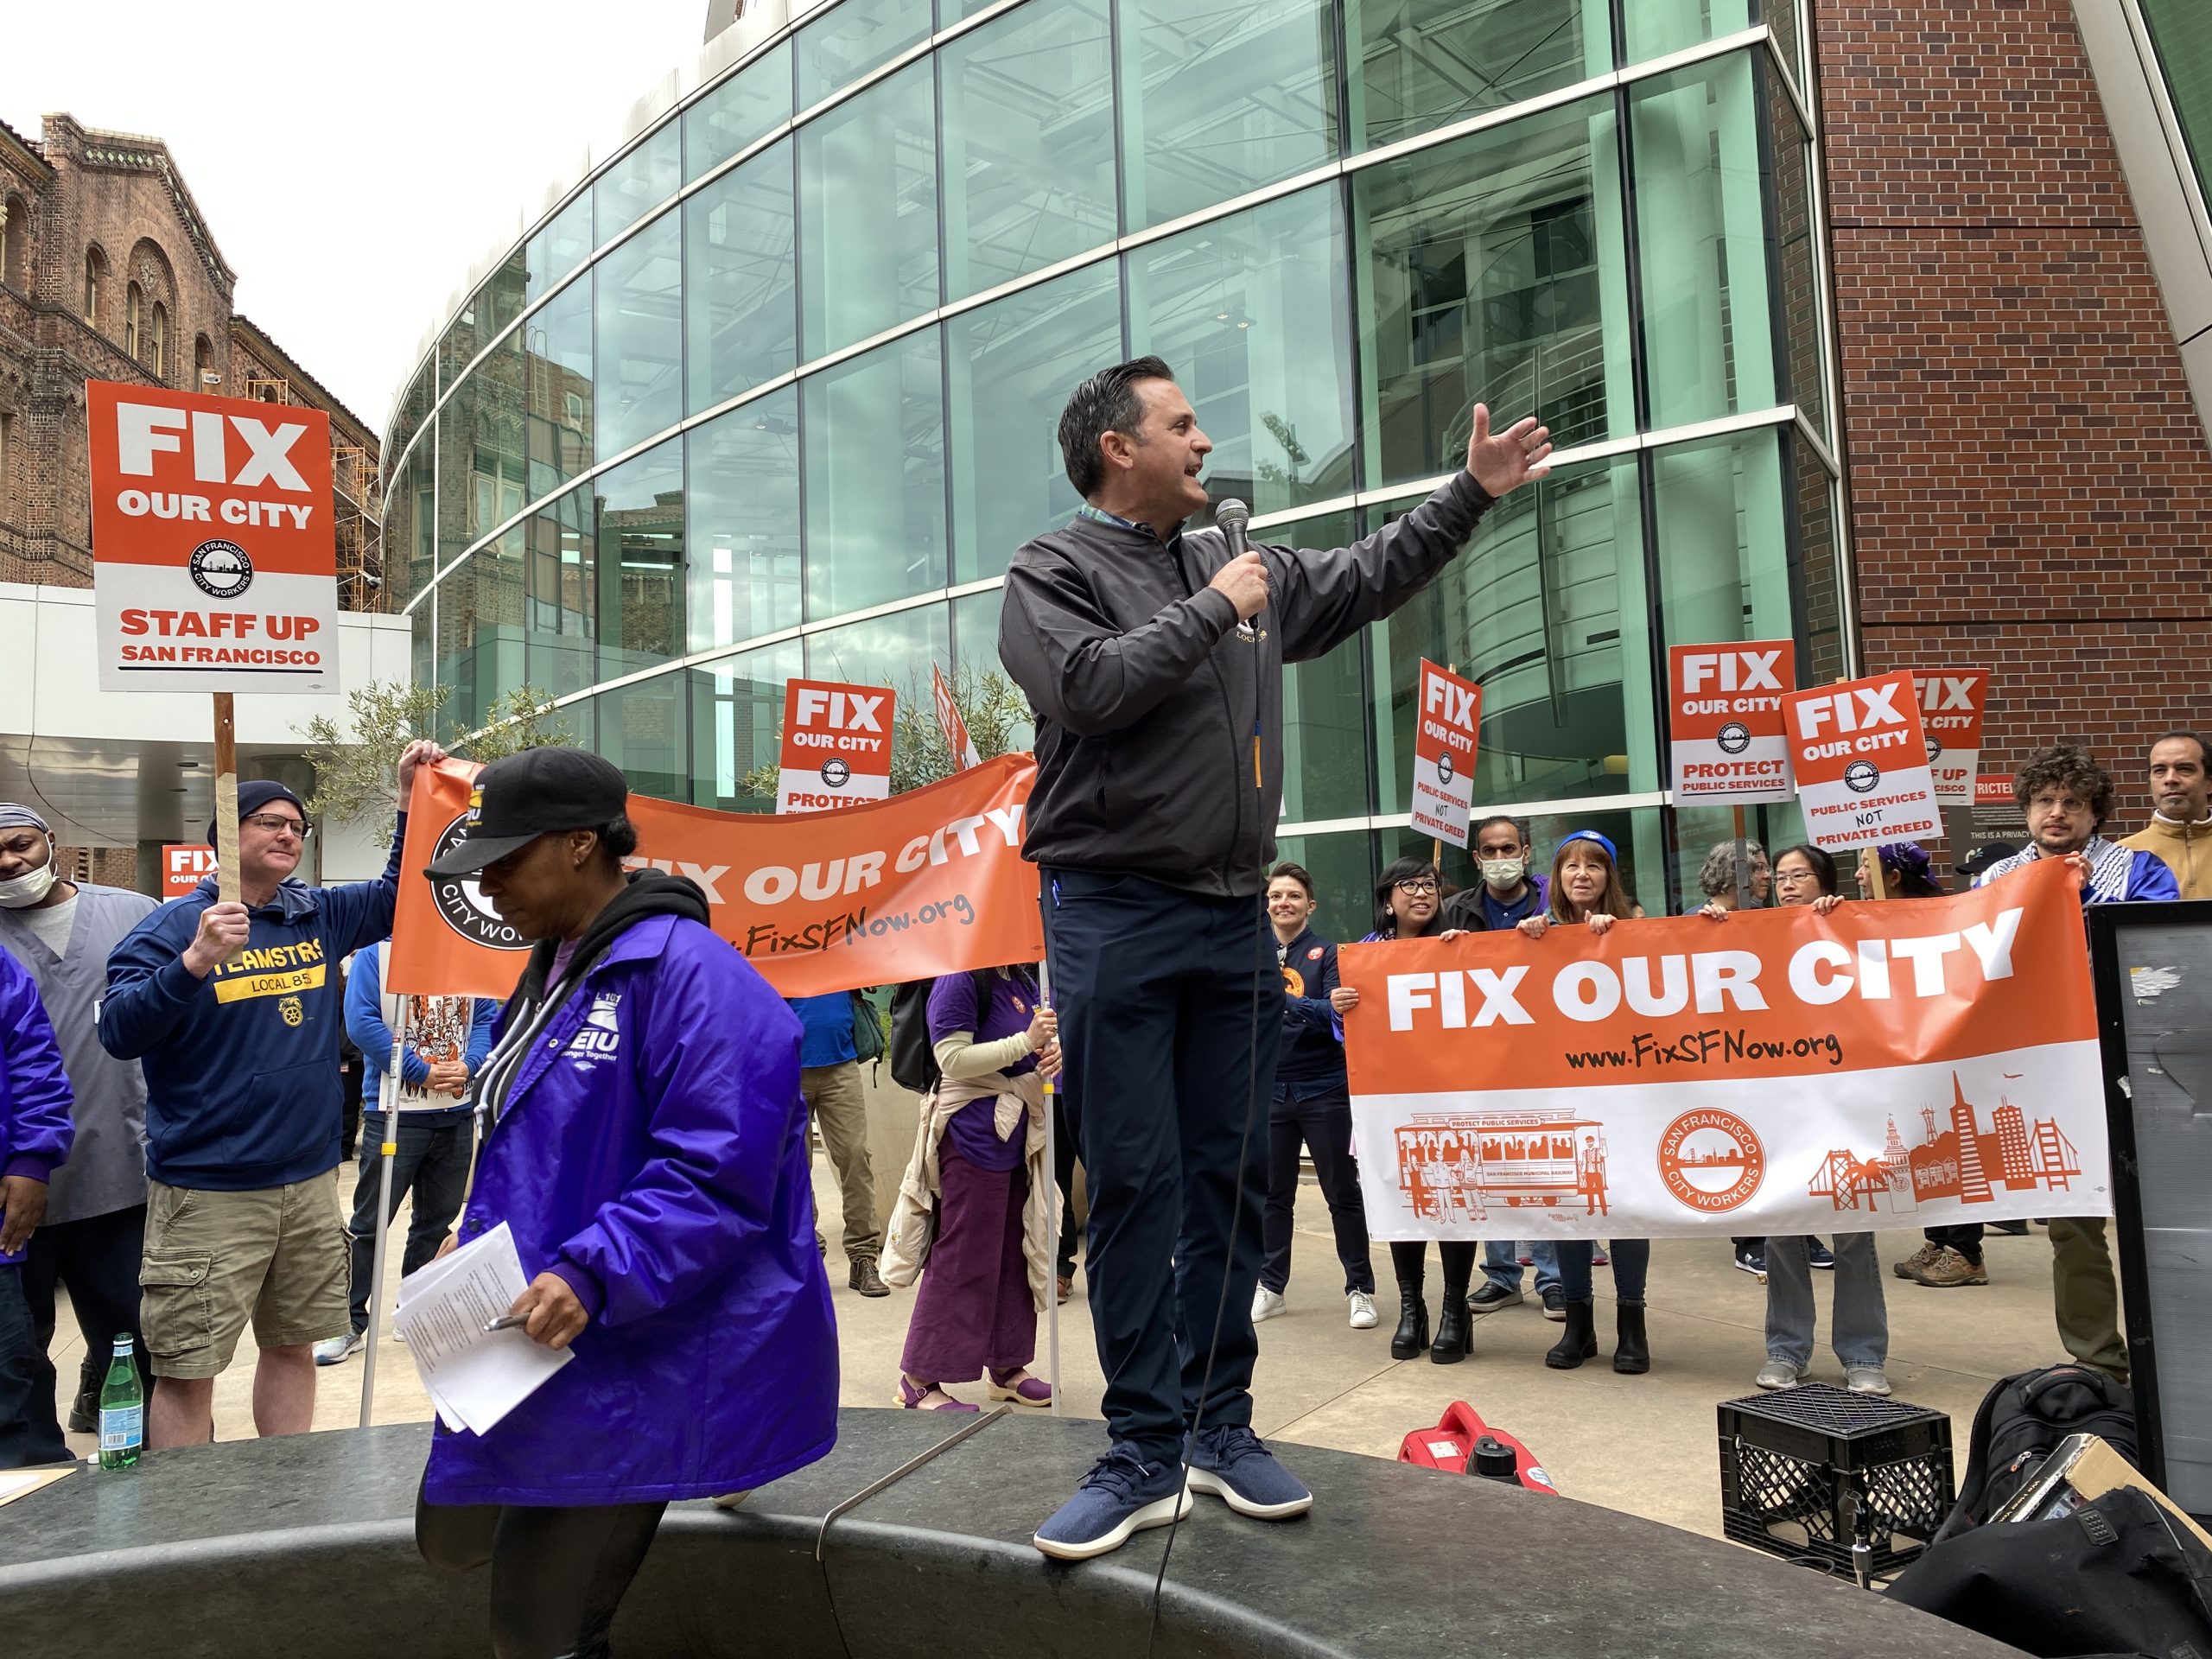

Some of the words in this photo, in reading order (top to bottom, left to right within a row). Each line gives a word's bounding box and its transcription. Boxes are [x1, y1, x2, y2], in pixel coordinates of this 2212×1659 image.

[117, 402, 312, 493] FIX
[117, 489, 213, 522] OUR
[219, 498, 314, 530] CITY
[193, 549, 207, 565] SAN
[205, 543, 250, 569] FRANCISCO
[195, 573, 212, 590] CITY
[212, 575, 250, 596] WORKERS
[120, 608, 257, 639] STAFF
[266, 615, 320, 640] UP
[121, 645, 176, 662] SAN
[182, 646, 320, 665] FRANCISCO
[1683, 650, 1783, 694] FIX
[796, 688, 885, 733] FIX
[1427, 671, 1477, 733] FIX
[1682, 699, 1729, 715] OUR
[1733, 696, 1782, 713] CITY
[1796, 682, 1908, 741] FIX
[1931, 716, 1974, 728] CITY
[793, 732, 835, 749] OUR
[838, 736, 882, 753] CITY
[1424, 720, 1447, 743] OUR
[1448, 731, 1473, 753] CITY
[1803, 740, 1853, 761] OUR
[1856, 729, 1910, 752] CITY
[1684, 760, 1784, 779] PROTECT
[1942, 769, 1967, 781] UP
[1417, 781, 1439, 798] PUBLIC
[1440, 791, 1468, 810] SERVICES
[1682, 782, 1726, 791] PUBLIC
[1728, 779, 1785, 789] SERVICES
[1435, 804, 1448, 817] NOT
[1810, 802, 1858, 817] PUBLIC
[1859, 791, 1928, 809] SERVICES
[1415, 811, 1443, 830] PRIVATE
[1444, 823, 1465, 839] GREED
[1855, 809, 1884, 828] NOT
[1816, 827, 1879, 846] PRIVATE
[1881, 820, 1934, 836] GREED
[1971, 831, 1986, 840] THIS
[171, 850, 219, 872] FIX
[743, 850, 887, 905] OUR
[895, 804, 1024, 874] CITY
[170, 874, 199, 884] OUR
[442, 884, 479, 925] CITY
[730, 894, 976, 957] .FixSFNow.org
[1387, 965, 1536, 1033] FIX
[1553, 950, 1770, 1022] OUR
[1788, 906, 2024, 1006] CITY
[251, 977, 291, 993] LOCAL
[570, 1031, 620, 1052] EIU
[1565, 1029, 1843, 1069] www.FixSFNow.org
[586, 1051, 617, 1061] Together
[1664, 1128, 1685, 1157] SAN
[1681, 1114, 1757, 1154] FRANCISCO
[1669, 1171, 1695, 1198] CITY
[1697, 1168, 1759, 1207] WORKERS
